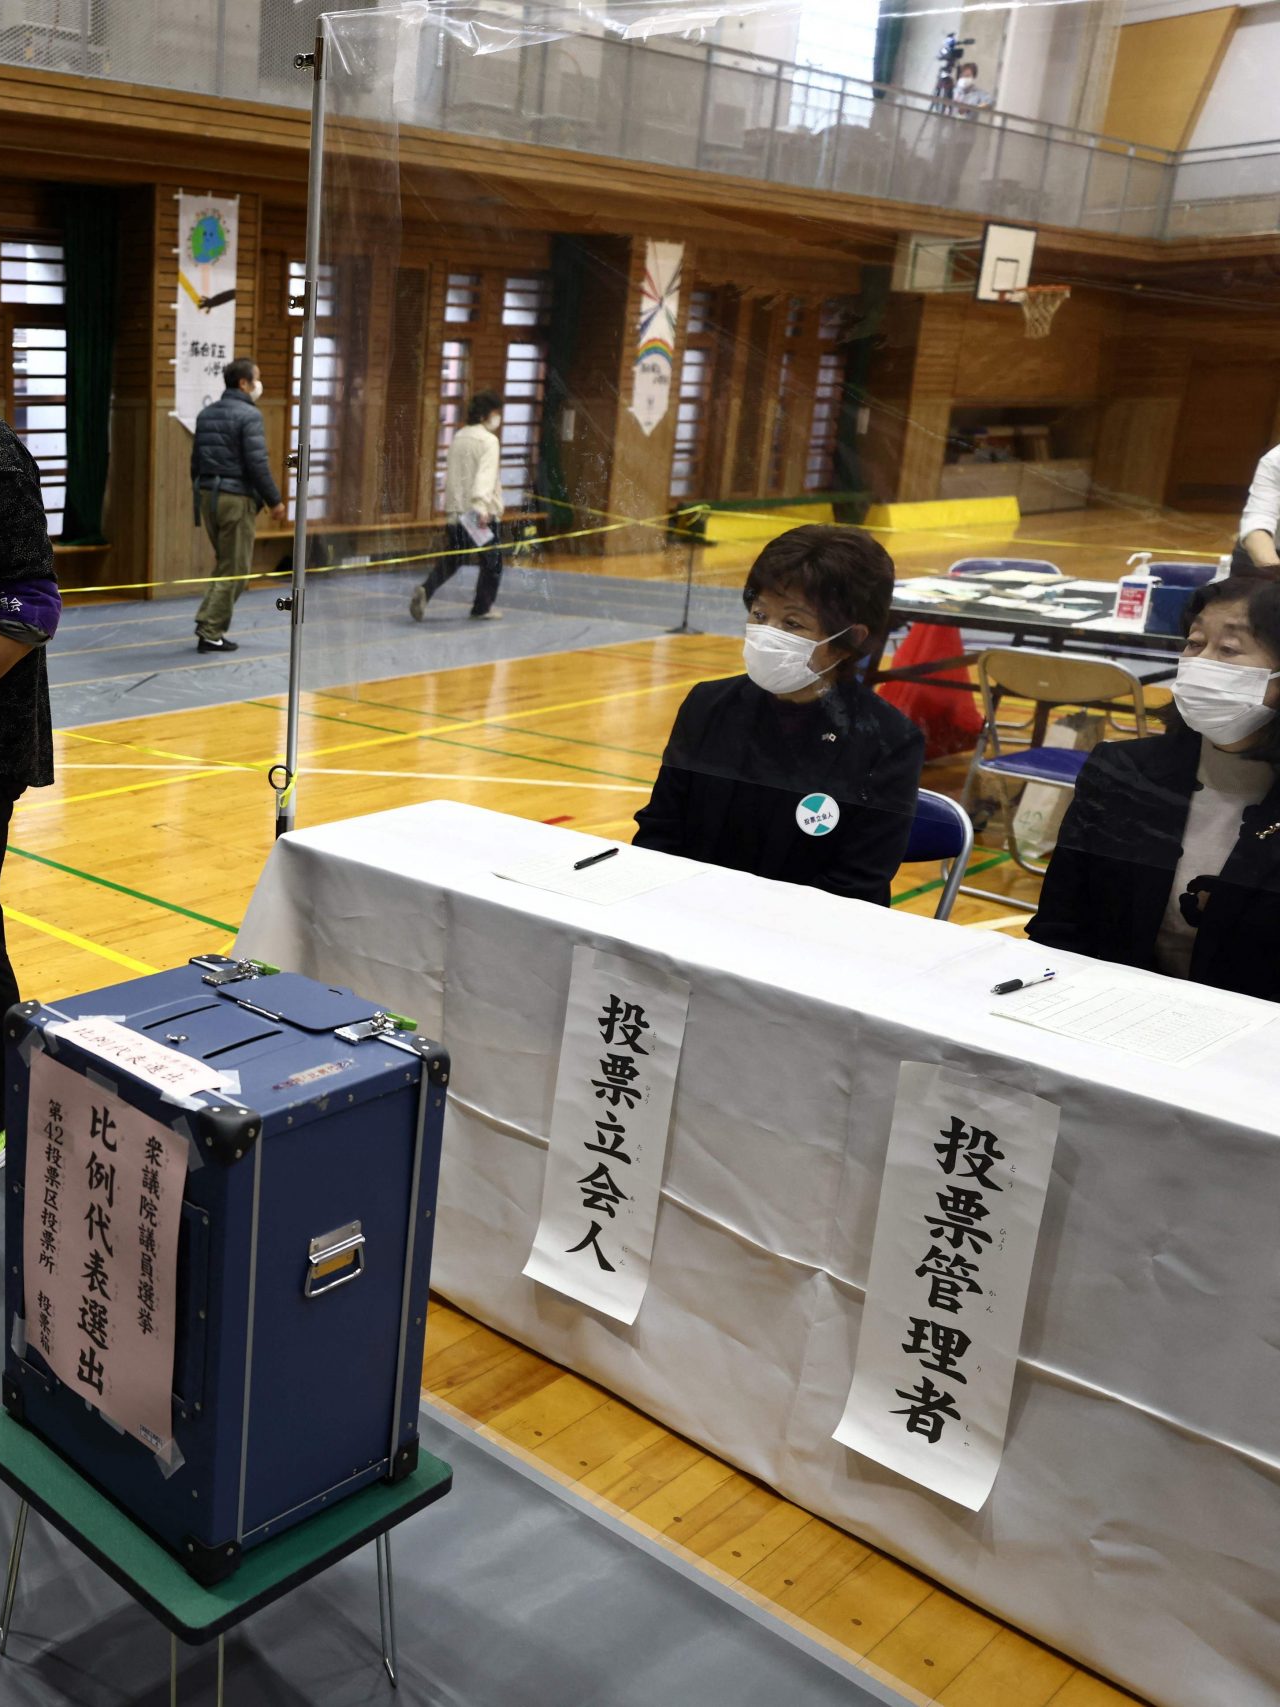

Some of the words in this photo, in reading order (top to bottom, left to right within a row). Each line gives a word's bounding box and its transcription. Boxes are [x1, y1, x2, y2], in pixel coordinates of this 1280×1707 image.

[38, 1099, 64, 1275] 第42投票区投票所
[77, 1105, 118, 1396] 比例代表選出
[137, 1135, 164, 1336] 衆議院議員選挙
[565, 994, 650, 1272] 投票立会人
[888, 1116, 1005, 1444] 投票管理者
